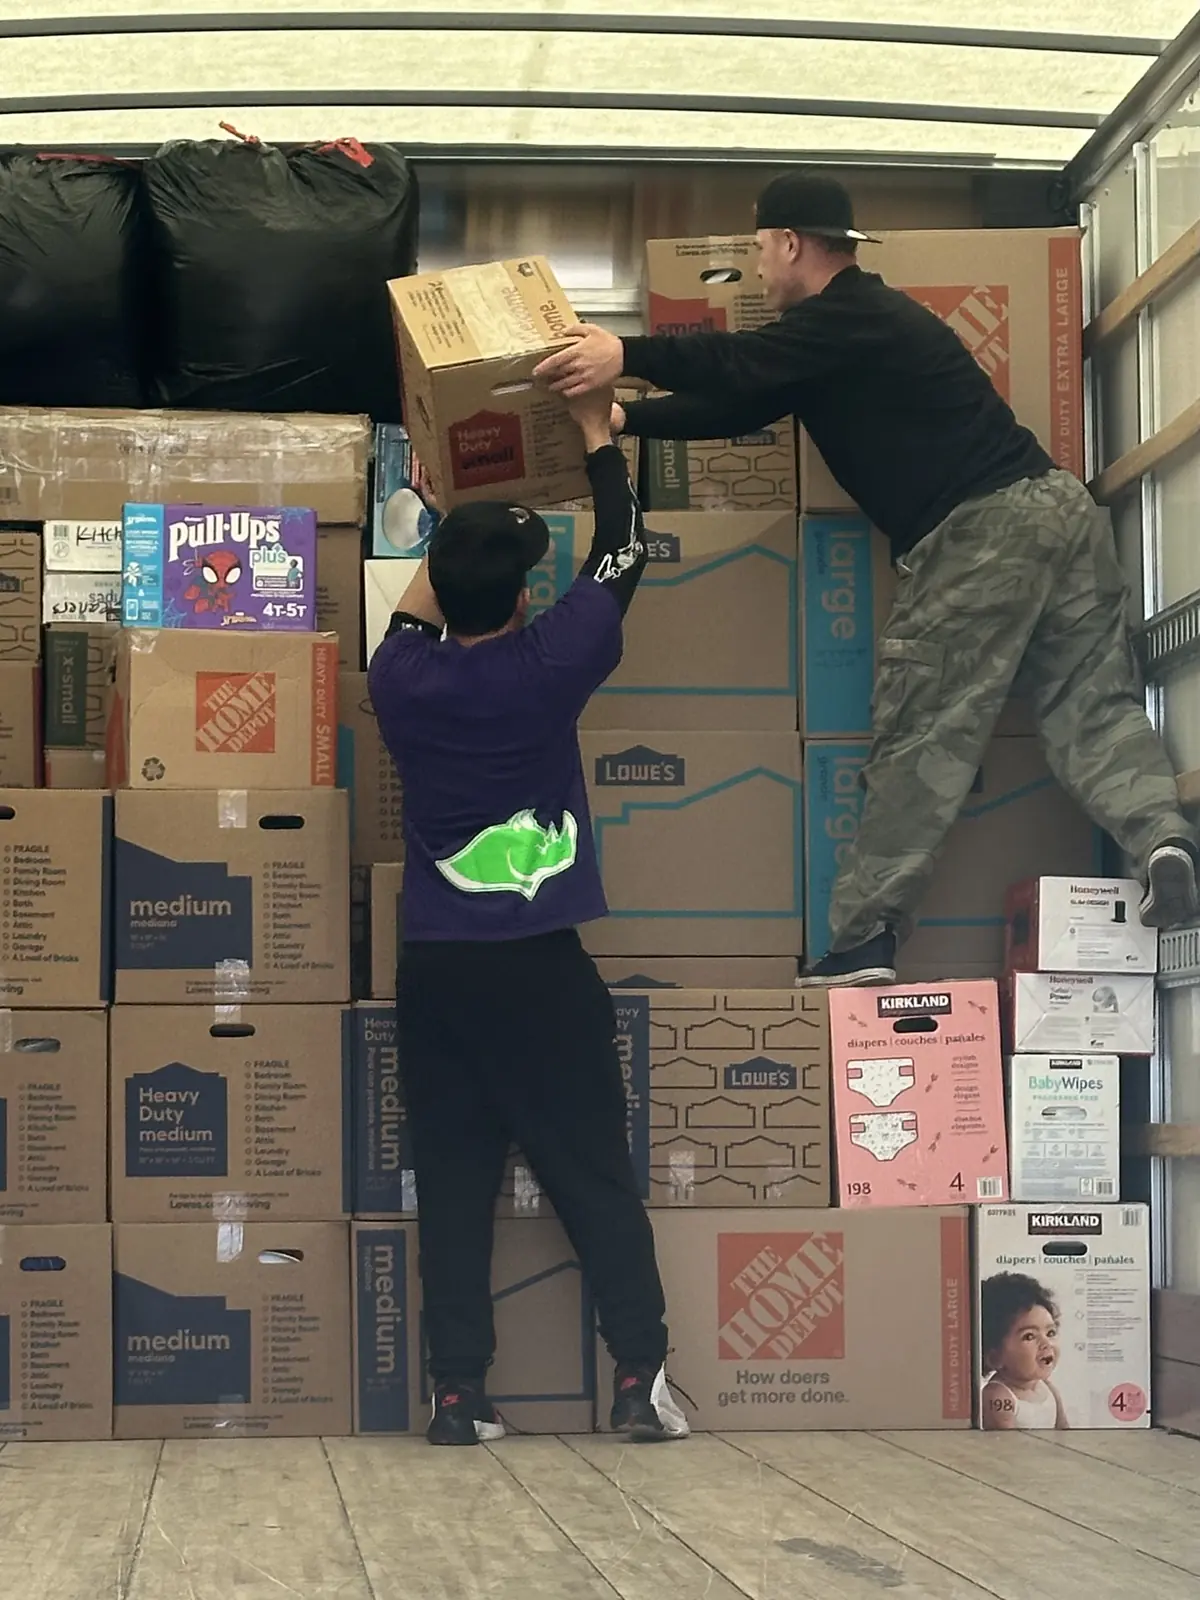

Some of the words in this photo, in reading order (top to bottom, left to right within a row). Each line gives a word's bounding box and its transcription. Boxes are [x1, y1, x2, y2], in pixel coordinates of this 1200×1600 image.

[1056, 267, 1069, 327] LARGE
[1056, 334, 1070, 392] EXTRA
[1058, 401, 1071, 436] DUTY
[458, 426, 501, 441] Heavy
[459, 440, 492, 453] Duty
[1060, 443, 1072, 469] AVY
[252, 546, 287, 566] plus
[647, 541, 671, 559] E'S
[821, 530, 866, 640] large
[263, 603, 308, 618] 4T-5T
[316, 647, 327, 684] HEAVY
[61, 656, 79, 724] x-small
[207, 681, 238, 712] THE
[196, 671, 276, 752] HOME
[316, 689, 327, 719] DUTY
[226, 706, 276, 753] DEPOT
[315, 724, 331, 783] SMALL
[605, 760, 676, 782] LOWE'S
[13, 845, 49, 853] FRAGILE
[1070, 884, 1120, 895] Honeywell
[130, 894, 232, 917] medium
[1049, 975, 1094, 985] Honeywell
[616, 1007, 640, 1019] avy
[881, 995, 949, 1010] KIRKLAND
[365, 1018, 397, 1030] Heav
[364, 1030, 395, 1043] Duty
[847, 1037, 888, 1050] diapers
[895, 1035, 938, 1047] couches
[945, 1033, 987, 1046] pañales
[732, 1069, 790, 1087] LOWE'S
[139, 1087, 200, 1106] Heavy
[139, 1106, 184, 1124] Duty
[380, 1046, 408, 1171] medium
[139, 1125, 213, 1142] medium
[847, 1182, 872, 1195] 198
[950, 1172, 965, 1192] 4
[1031, 1214, 1100, 1228] KIRKLAND
[729, 1245, 784, 1297] THE
[996, 1254, 1037, 1266] diapers
[1043, 1255, 1087, 1265] couches
[1094, 1255, 1135, 1267] pañales
[718, 1231, 844, 1361] HOME
[946, 1278, 960, 1330] LARGE
[374, 1245, 403, 1374] medium
[767, 1278, 844, 1361] DEPOT
[127, 1328, 231, 1351] medium
[949, 1335, 960, 1368] DUTY
[736, 1369, 775, 1385] How
[780, 1369, 830, 1385] doers
[718, 1389, 747, 1408] get
[751, 1391, 797, 1405] more
[800, 1388, 850, 1405] done.
[949, 1380, 960, 1412] HEAVY
[1111, 1392, 1128, 1413] 4
